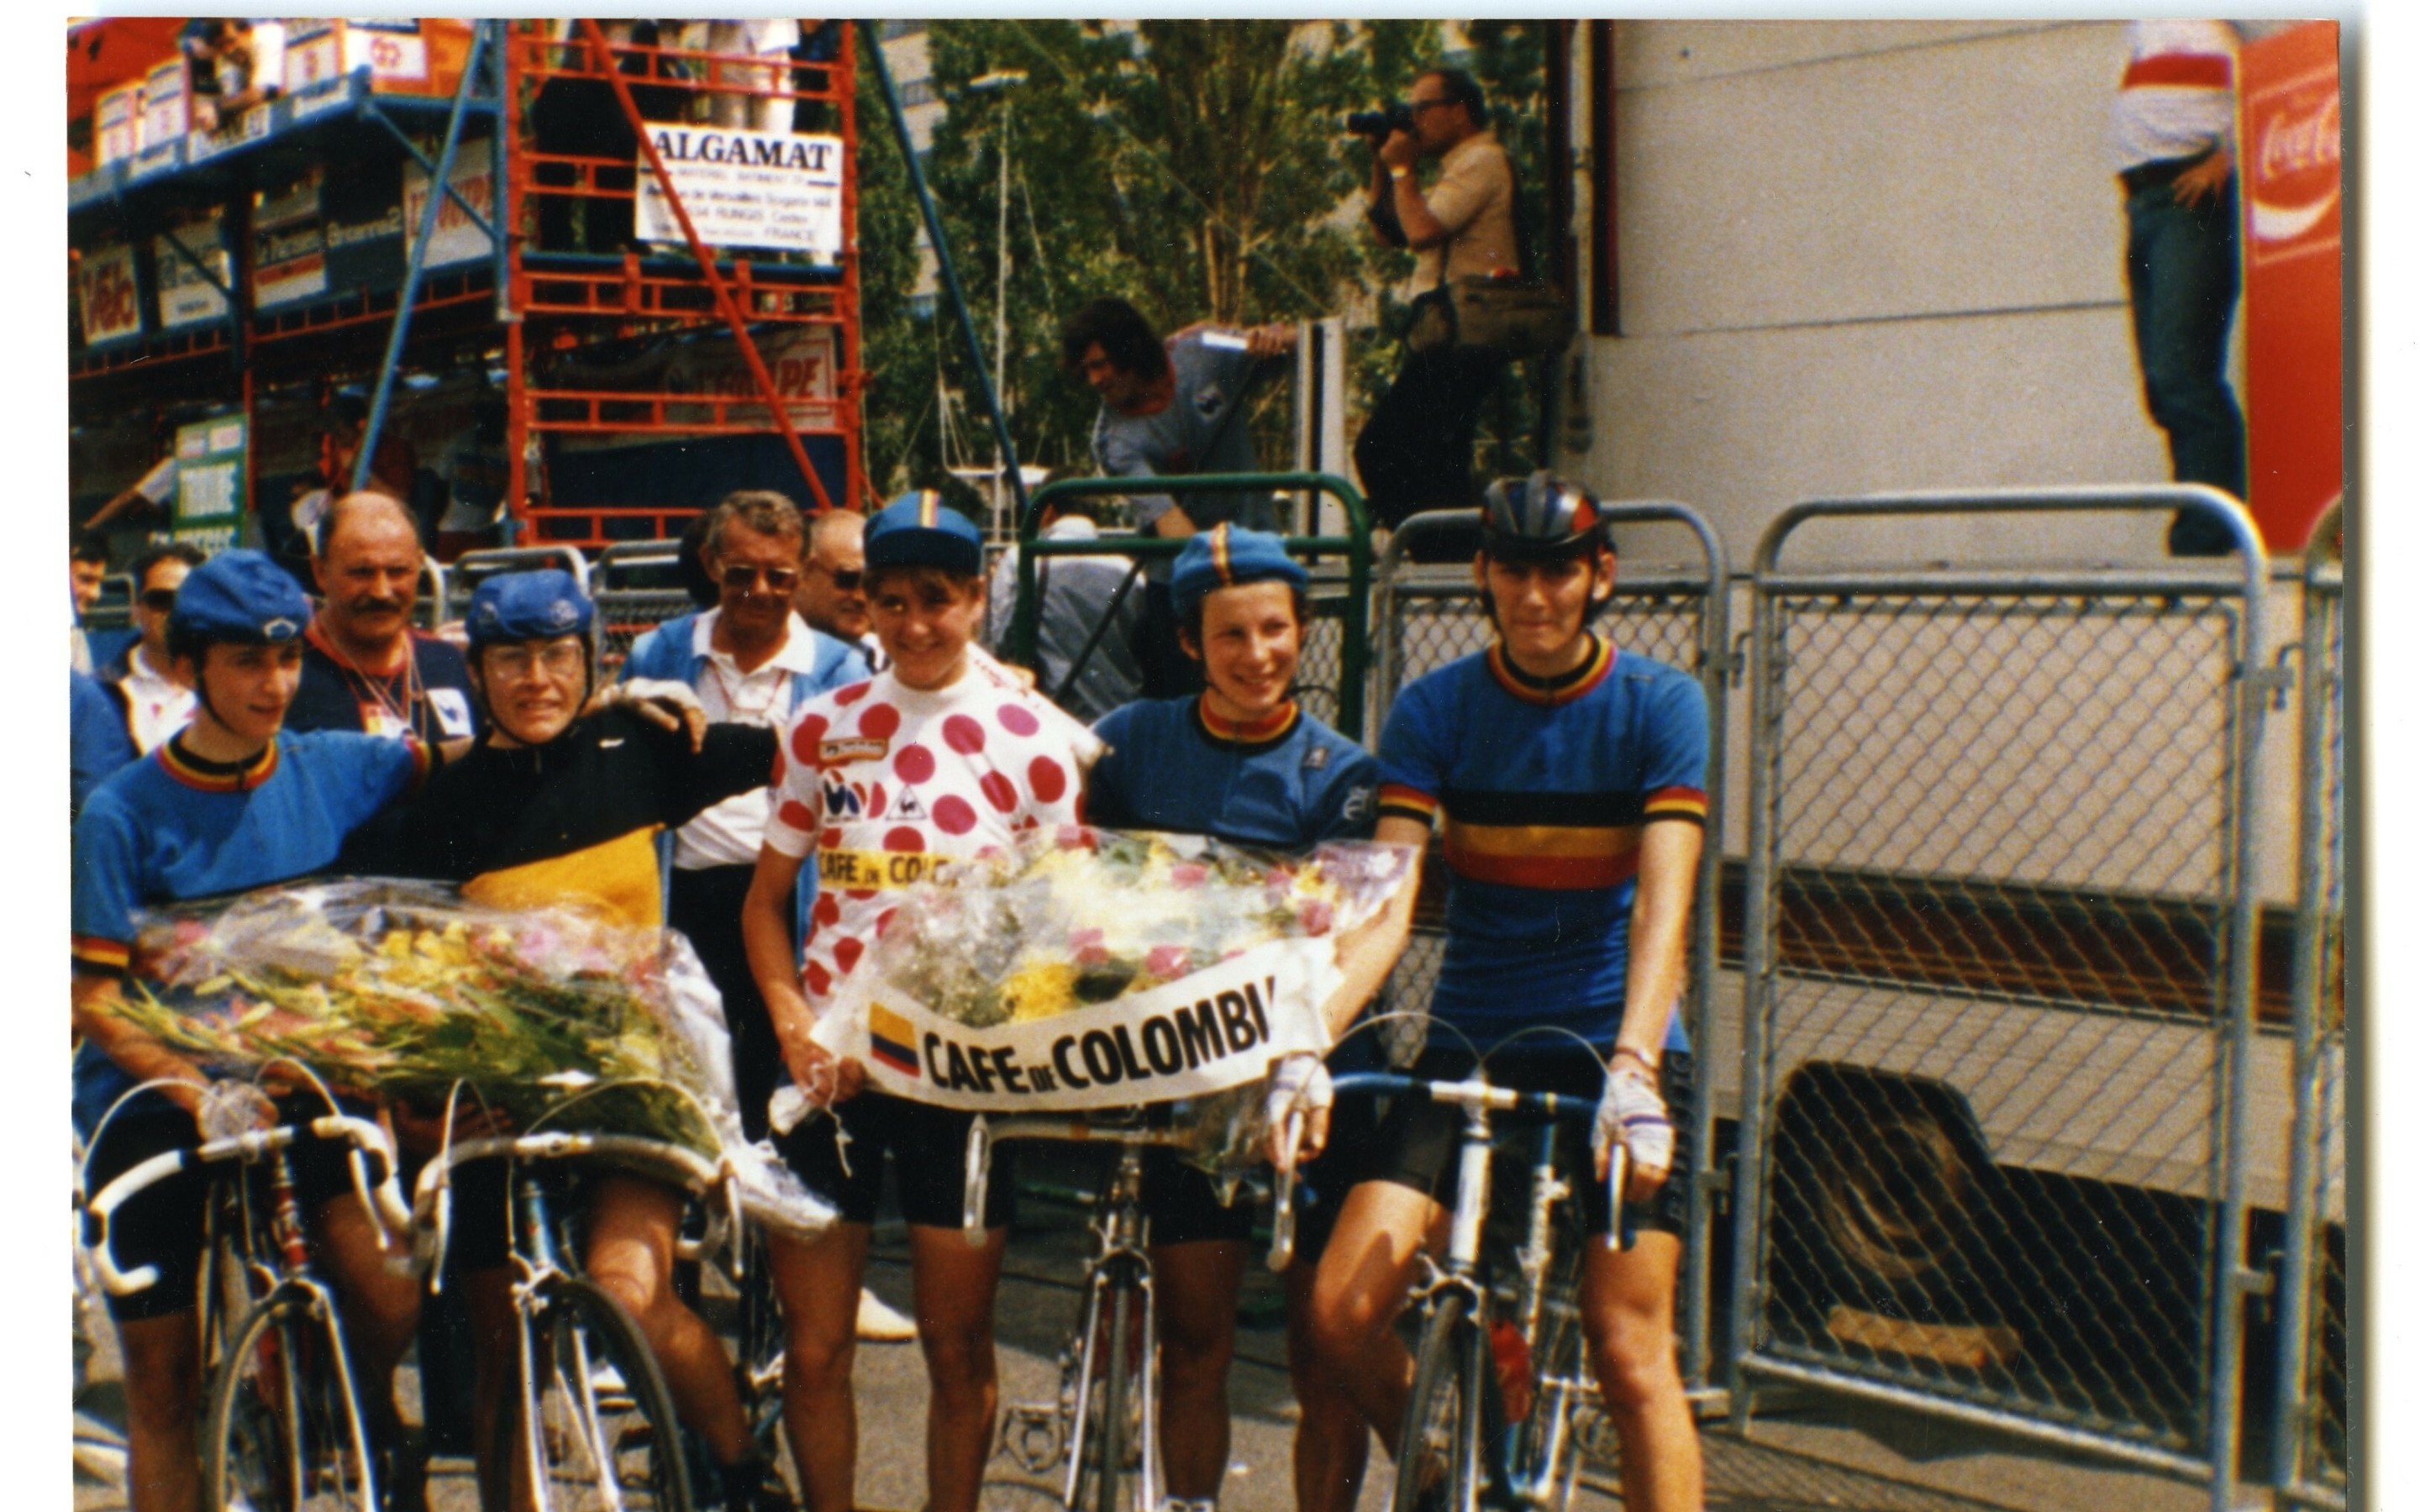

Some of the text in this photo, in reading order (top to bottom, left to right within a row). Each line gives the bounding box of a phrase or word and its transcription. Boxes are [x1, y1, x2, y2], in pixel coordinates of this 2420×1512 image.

[655, 131, 833, 170] ALGAMAT
[924, 1032, 1030, 1094] CAFE
[1028, 1065, 1058, 1092] DE
